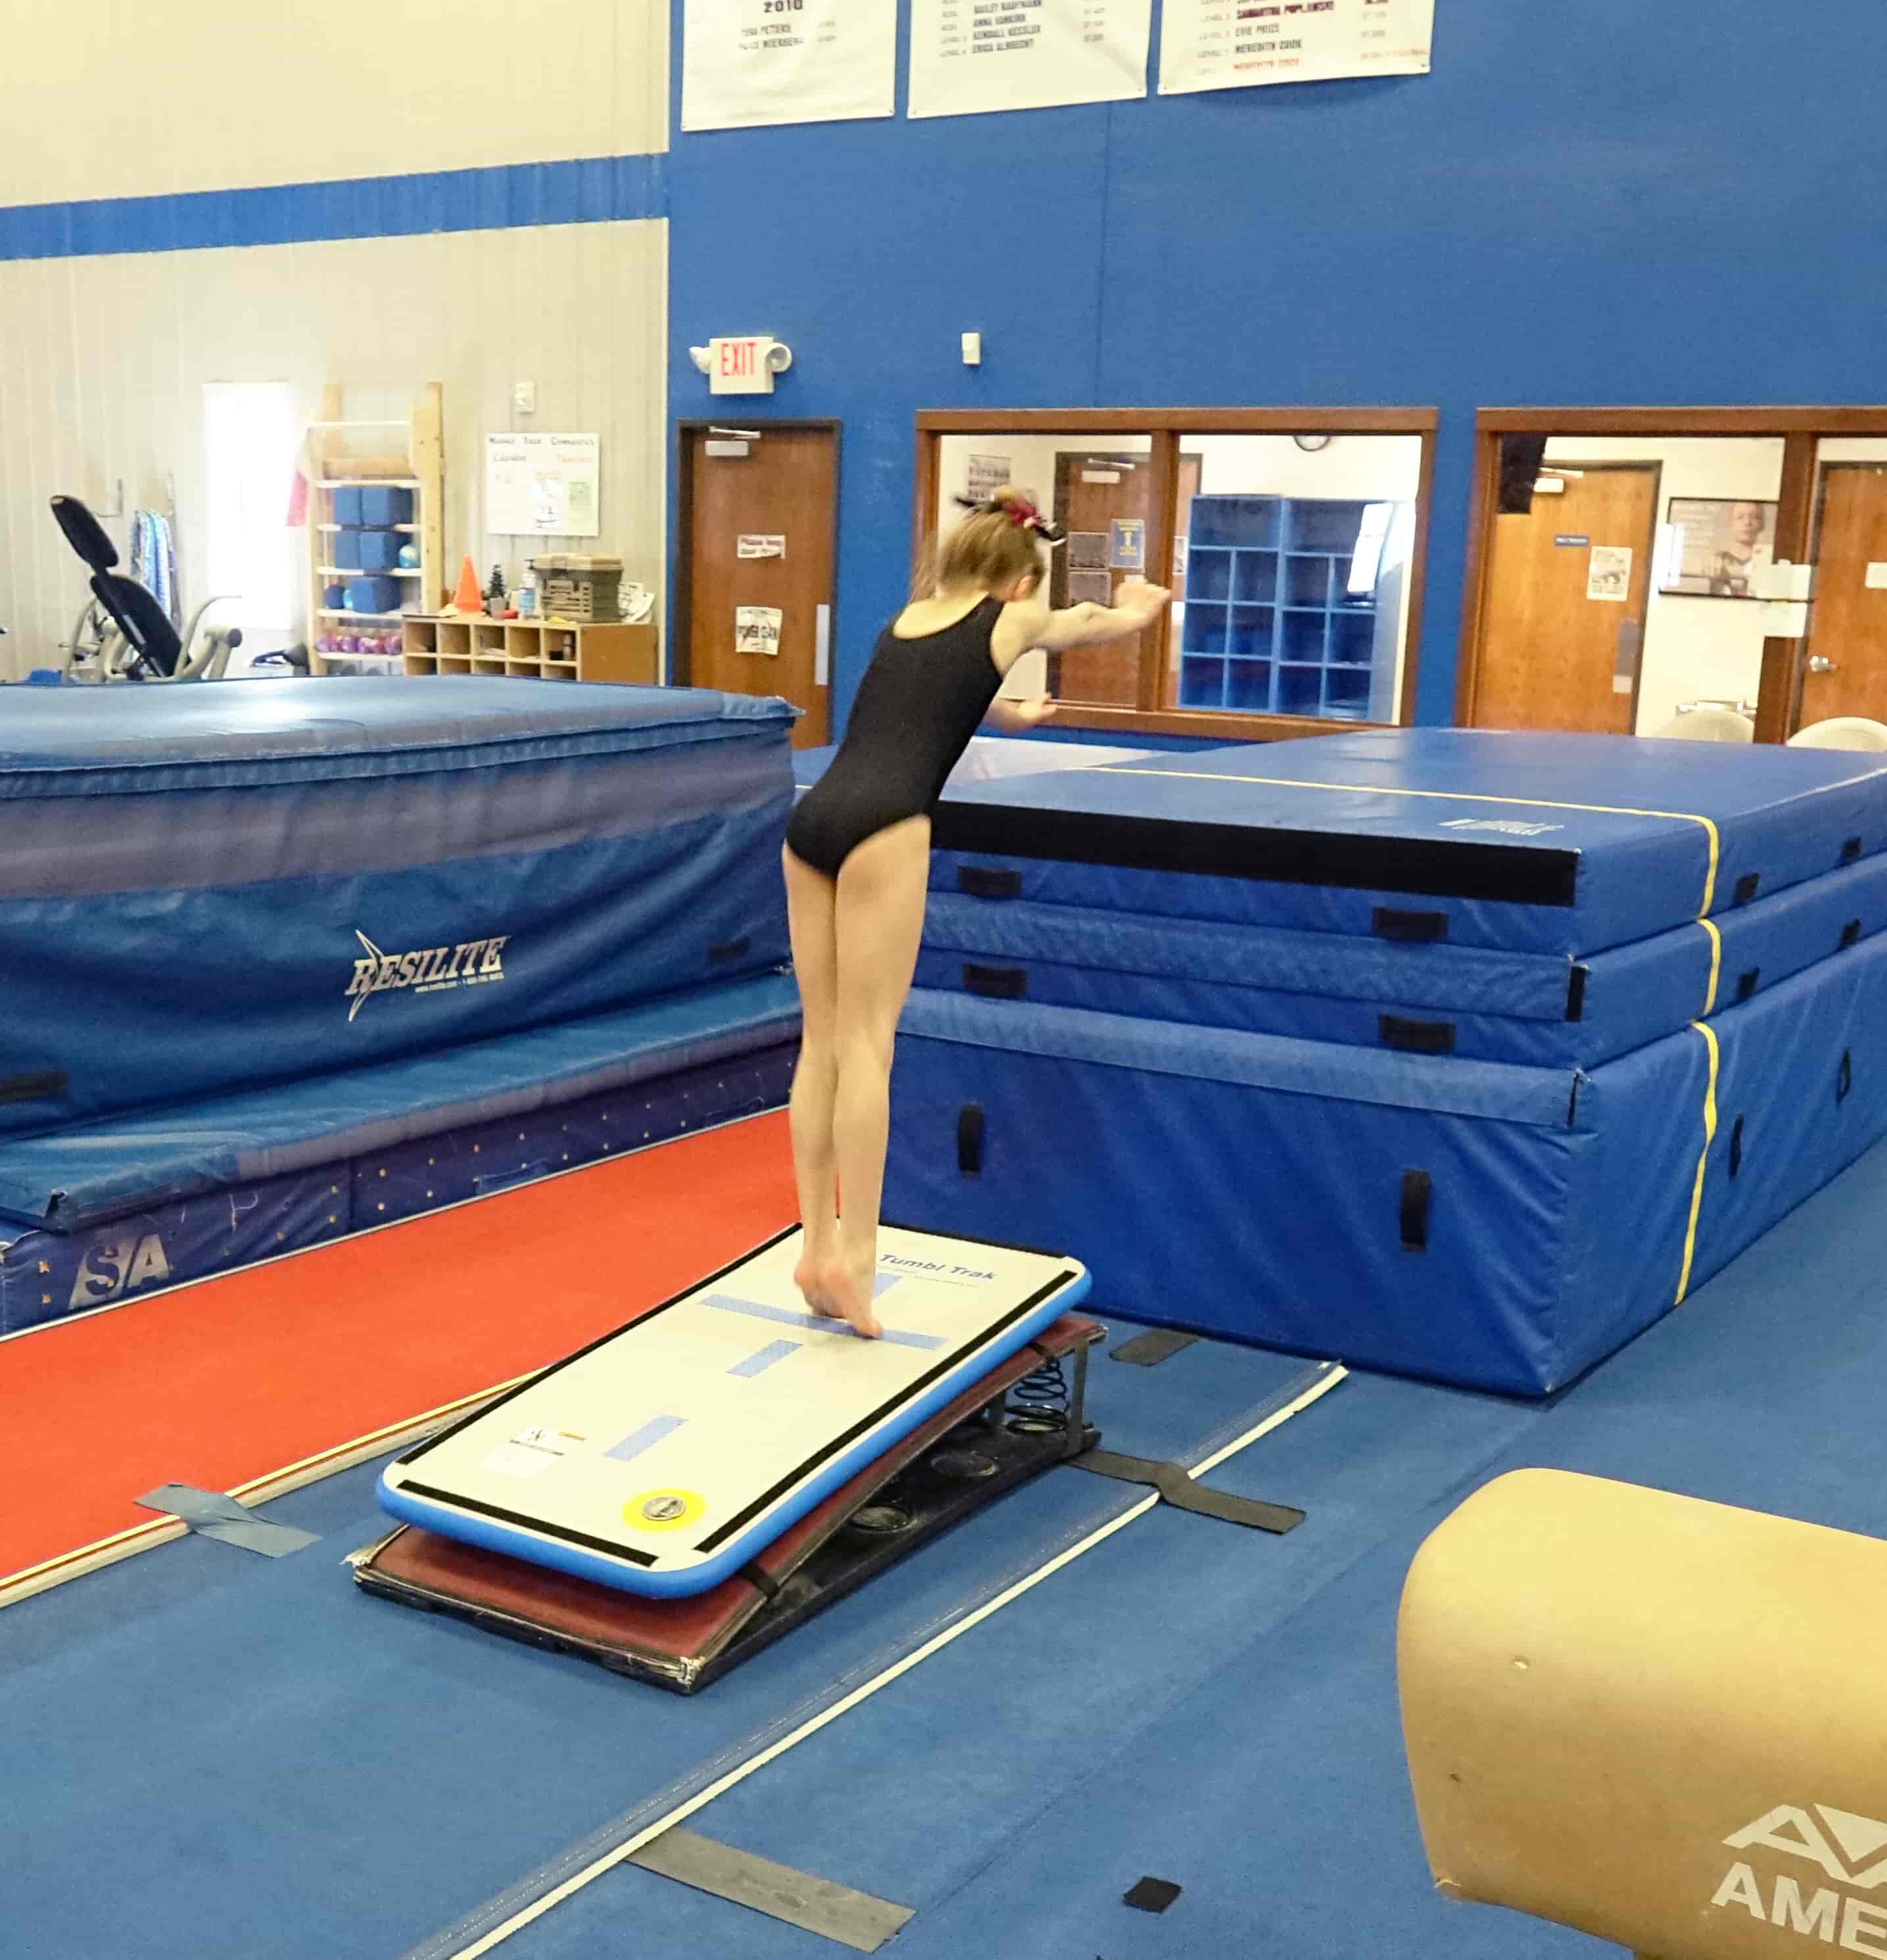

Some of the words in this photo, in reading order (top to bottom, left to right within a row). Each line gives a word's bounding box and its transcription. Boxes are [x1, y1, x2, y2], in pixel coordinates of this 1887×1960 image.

[763, 0, 803, 12] 2010
[721, 342, 757, 376] EXIT
[344, 936, 512, 995] RESILITE
[880, 1253, 946, 1272] Tumbl
[949, 1266, 996, 1280] Trak
